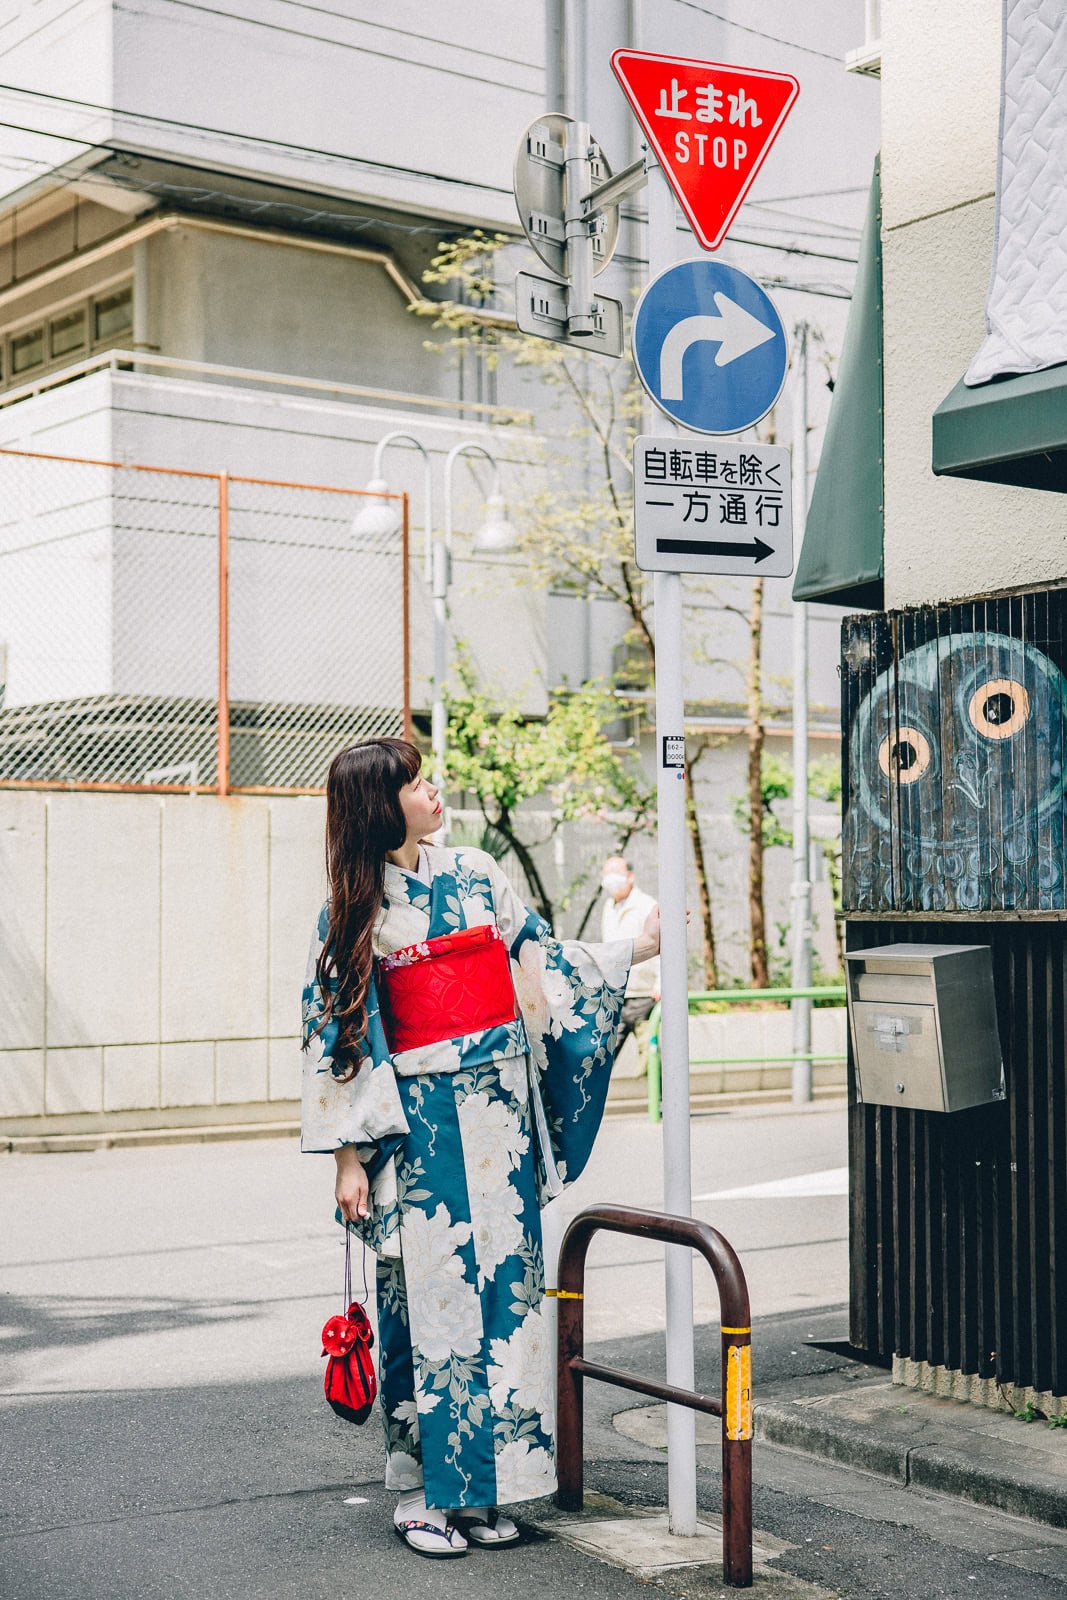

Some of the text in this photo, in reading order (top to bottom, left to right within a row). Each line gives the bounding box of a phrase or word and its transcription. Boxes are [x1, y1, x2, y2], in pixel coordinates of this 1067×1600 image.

[654, 78, 763, 128] 止まれ
[675, 131, 747, 170] STOP
[644, 447, 781, 486] 自転車を除く
[646, 491, 783, 527] 一方通行
